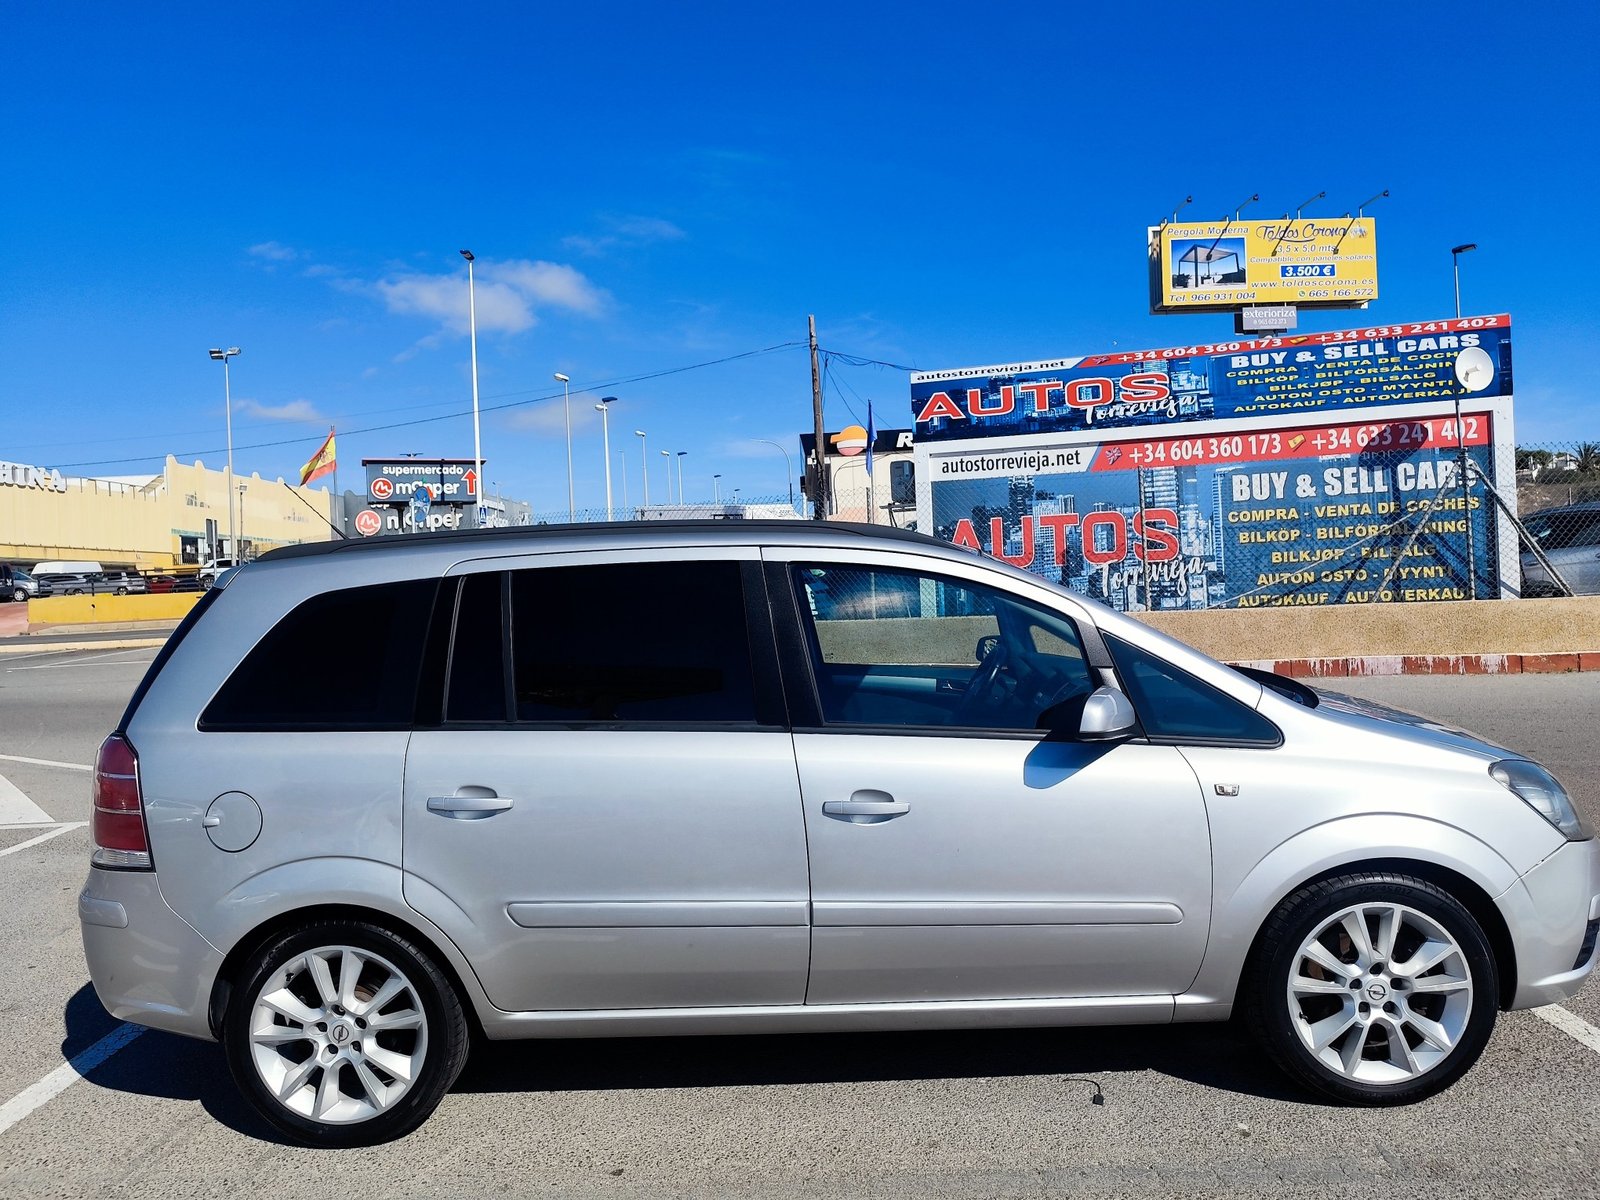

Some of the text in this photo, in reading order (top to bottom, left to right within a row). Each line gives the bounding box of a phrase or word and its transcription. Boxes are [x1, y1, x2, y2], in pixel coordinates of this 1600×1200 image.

[1167, 226, 1249, 237] Pergola Moderna
[1256, 223, 1347, 242] Toldos Corona
[1312, 255, 1343, 263] paneles
[1285, 266, 1332, 276] 3.500 €
[1191, 293, 1211, 301] 966
[1236, 292, 1256, 300] 004
[1354, 288, 1374, 296] 572
[1243, 309, 1296, 318] exterioriza
[1315, 317, 1498, 342] +34 633 241 402
[1118, 338, 1283, 362] +34 604 360 173
[1231, 333, 1480, 369] BUY & SELL CARS
[917, 359, 1066, 380] autostorrevieja.net
[1226, 366, 1298, 378] COMPRA
[1314, 359, 1371, 370] VENTA
[1378, 356, 1401, 364] DE
[1407, 351, 1459, 361] COCH
[1237, 375, 1299, 386] BILKÖP
[1269, 380, 1343, 392] BILKJØP
[1360, 372, 1436, 384] BILSALG
[915, 372, 1171, 422] AUTOS
[1254, 391, 1313, 402] AUTON
[1318, 387, 1366, 396] OSTO
[1382, 380, 1453, 391] MYYNTI
[1082, 393, 1198, 425] Torrevieja
[1233, 399, 1327, 412] AUTOKAUF
[1311, 418, 1478, 451] +34 633 241 402
[1129, 434, 1282, 464] +34 604 360 173
[382, 464, 464, 477] supermercado
[941, 448, 1081, 475] autostorrevieja.net
[1232, 459, 1477, 502] BUY & SELL CARS
[1228, 508, 1299, 523] COMPRA
[1314, 503, 1372, 518] VENTA
[1377, 502, 1401, 514] DE
[1406, 497, 1480, 512] COCHES
[951, 507, 1180, 568] AUTOS
[1239, 527, 1301, 544] BILKÖP
[1361, 544, 1436, 559] BILSALG
[1099, 554, 1207, 597] Torrevieja
[1257, 571, 1315, 586] AUTON
[1320, 569, 1367, 583] OSTO
[1238, 592, 1329, 607] AUTOKAUF
